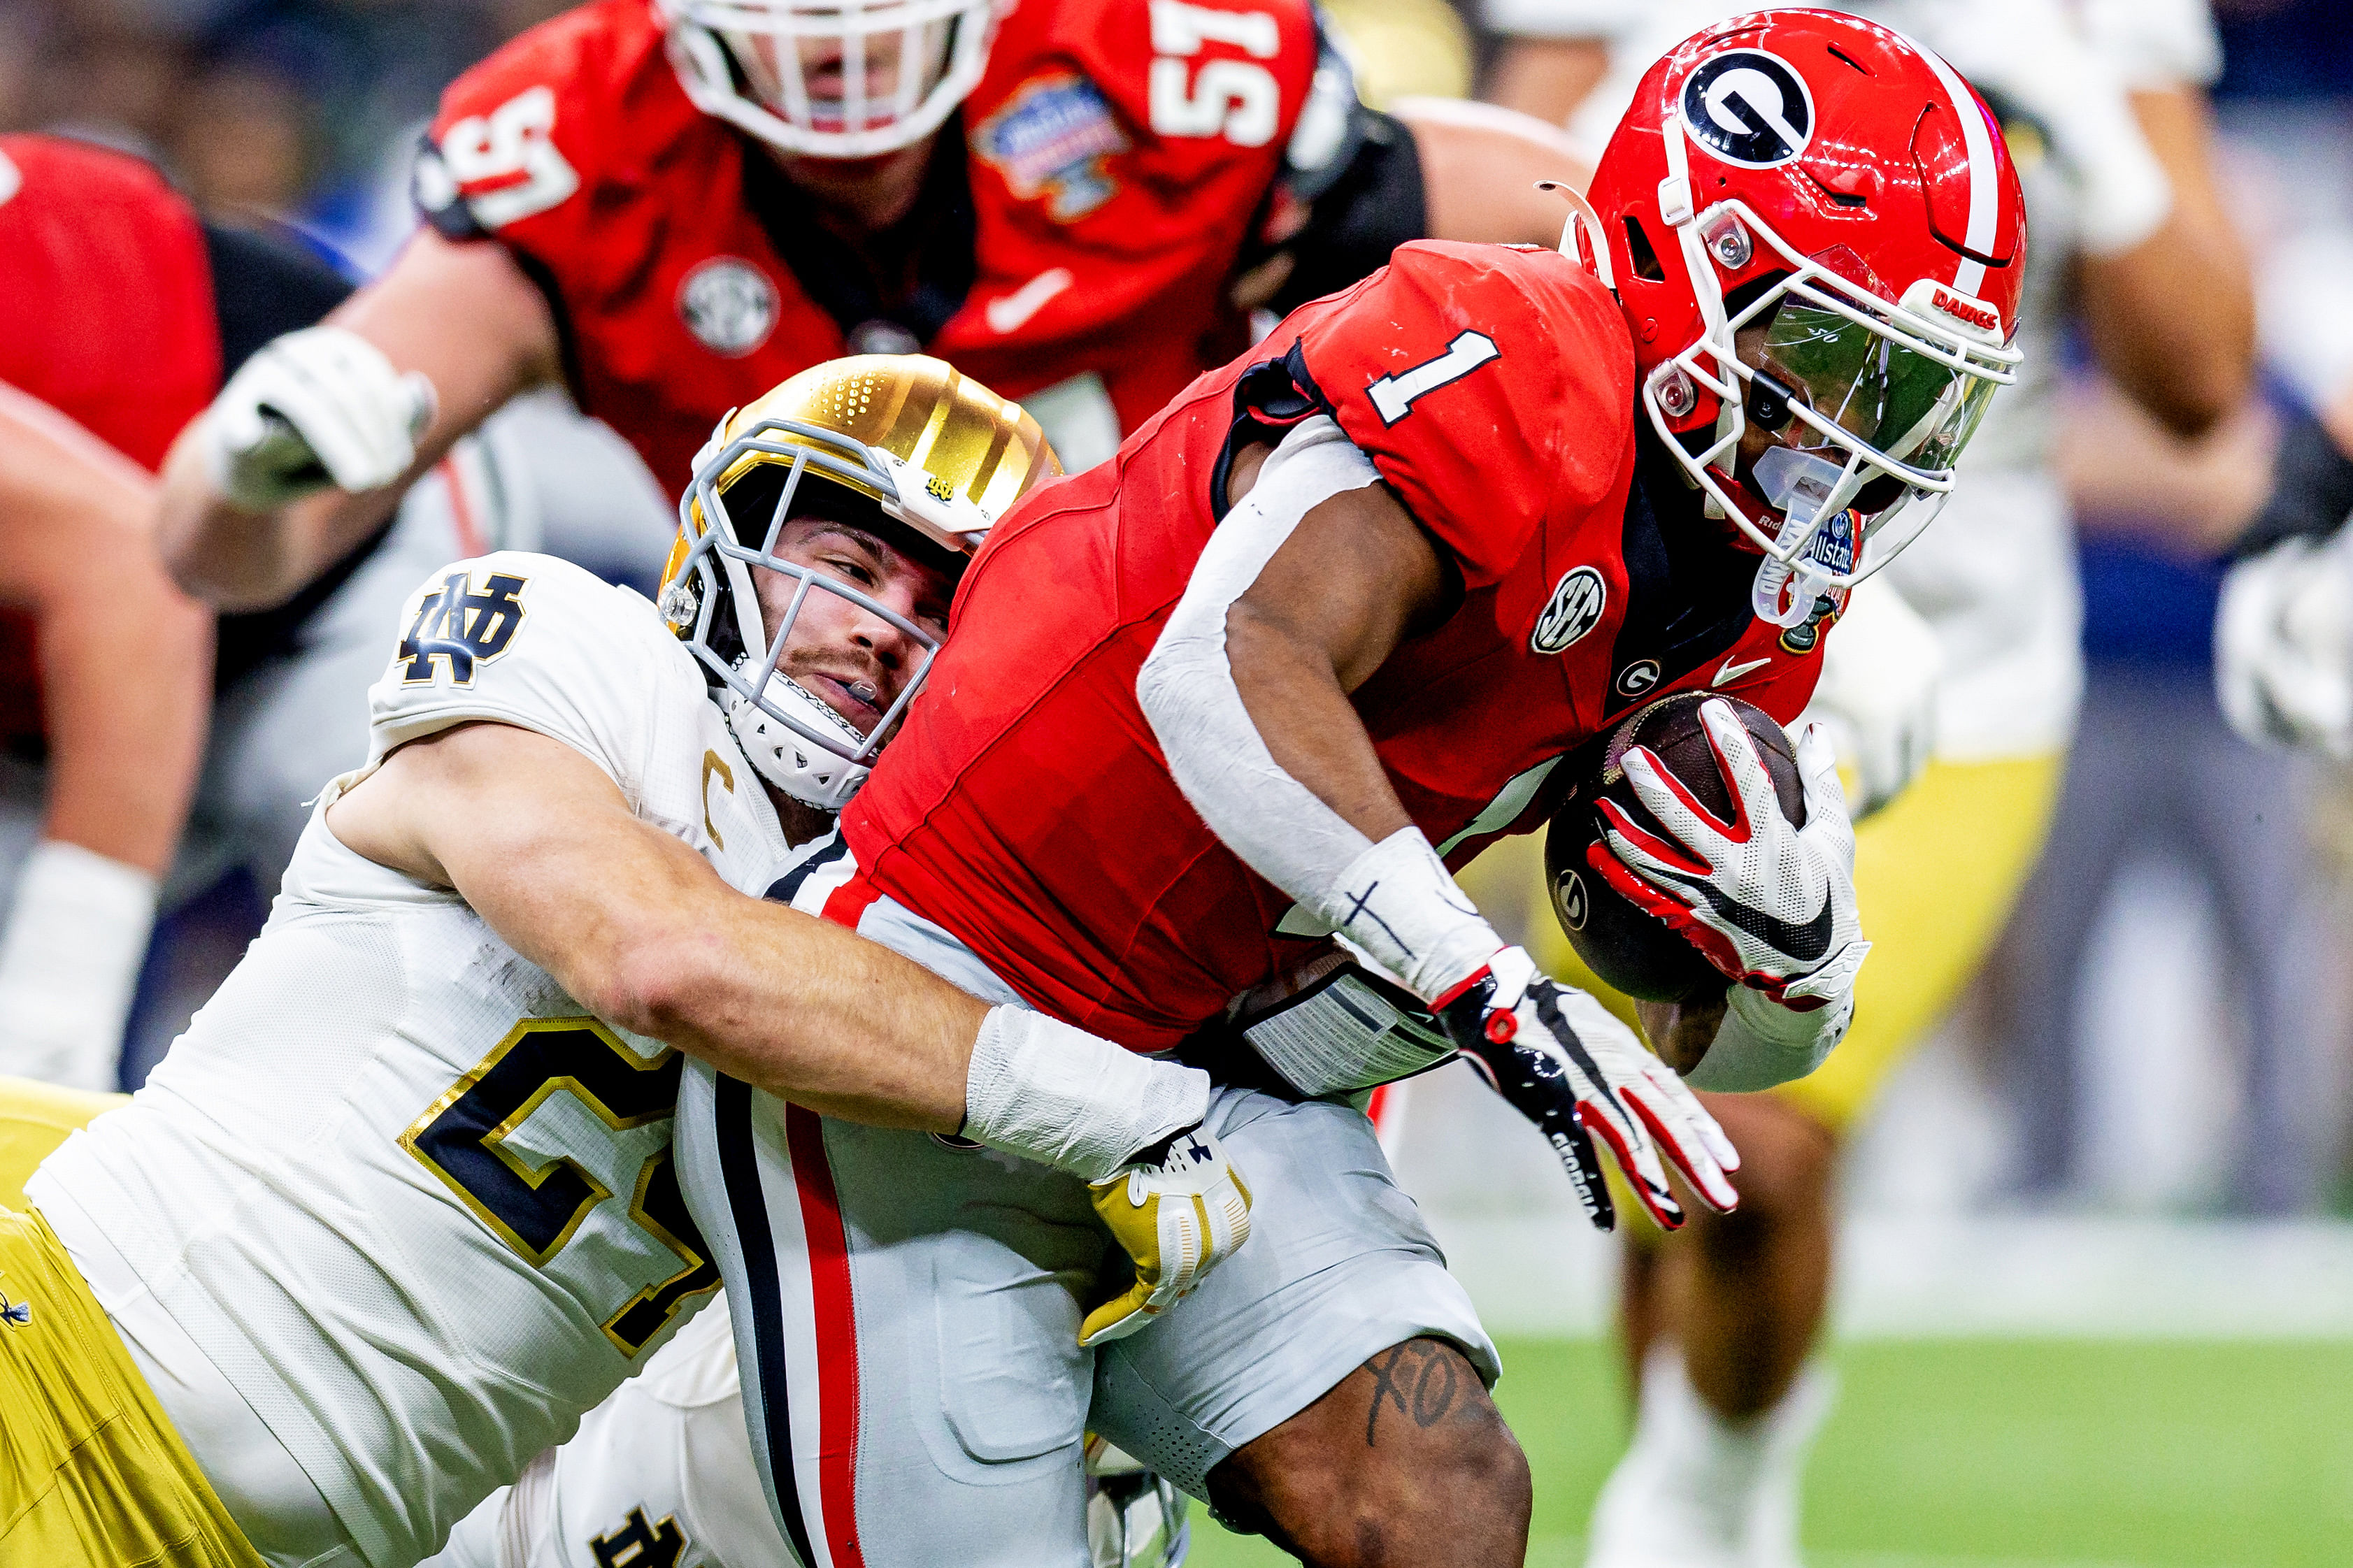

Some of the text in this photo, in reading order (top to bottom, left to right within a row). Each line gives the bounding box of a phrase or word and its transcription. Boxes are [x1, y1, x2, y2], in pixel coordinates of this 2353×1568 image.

[1931, 288, 1998, 331] DAWGS
[1364, 329, 1502, 430] 1
[396, 572, 529, 684] ND
[1537, 573, 1601, 649] SEC
[701, 749, 734, 851] C
